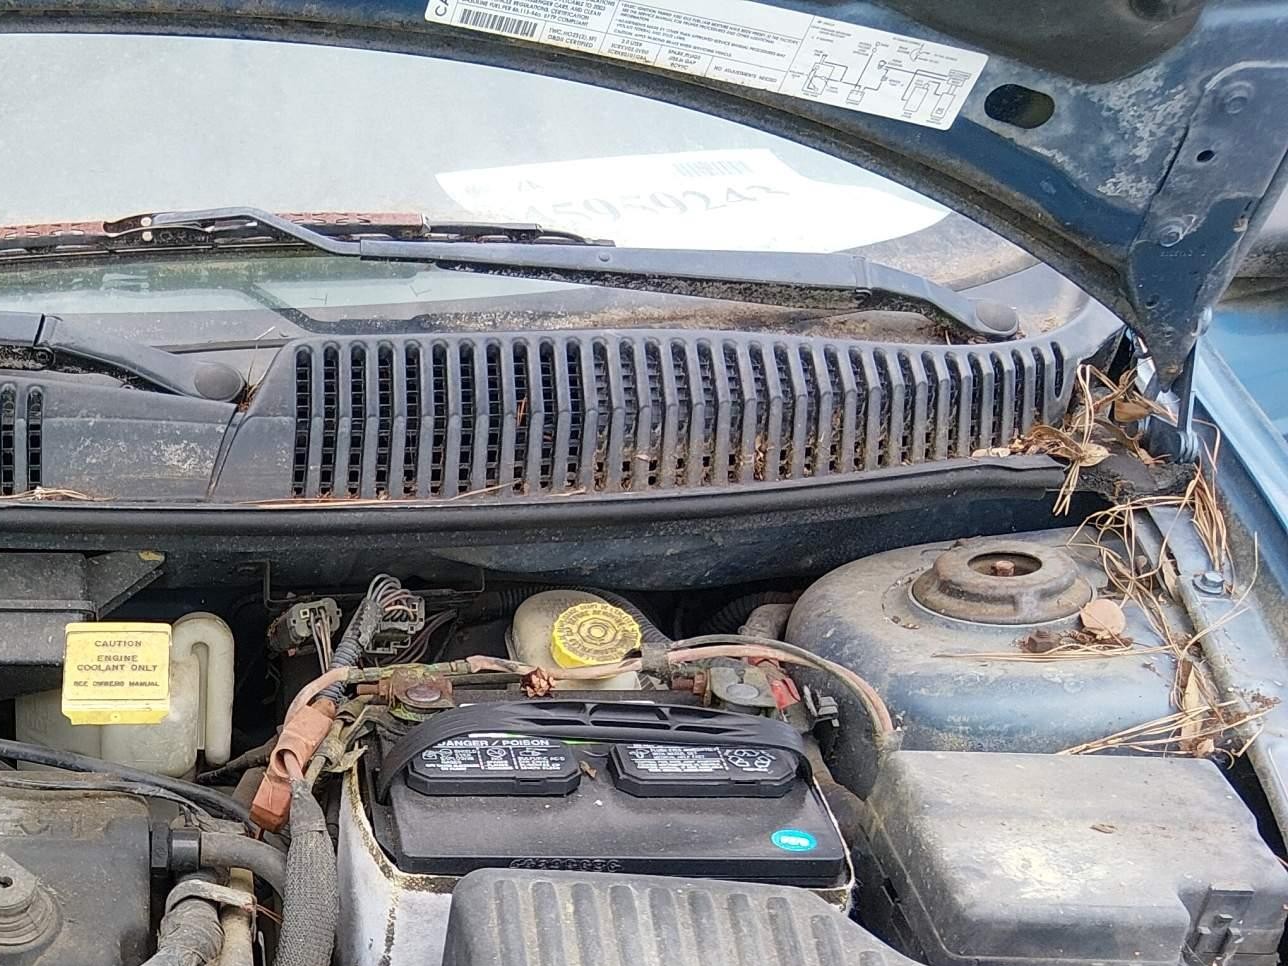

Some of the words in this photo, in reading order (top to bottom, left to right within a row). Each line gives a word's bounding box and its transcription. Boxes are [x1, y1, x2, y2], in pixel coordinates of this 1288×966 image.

[94, 640, 142, 648] CAUTION
[77, 664, 125, 672] COOLANT
[130, 664, 158, 672] ONLY
